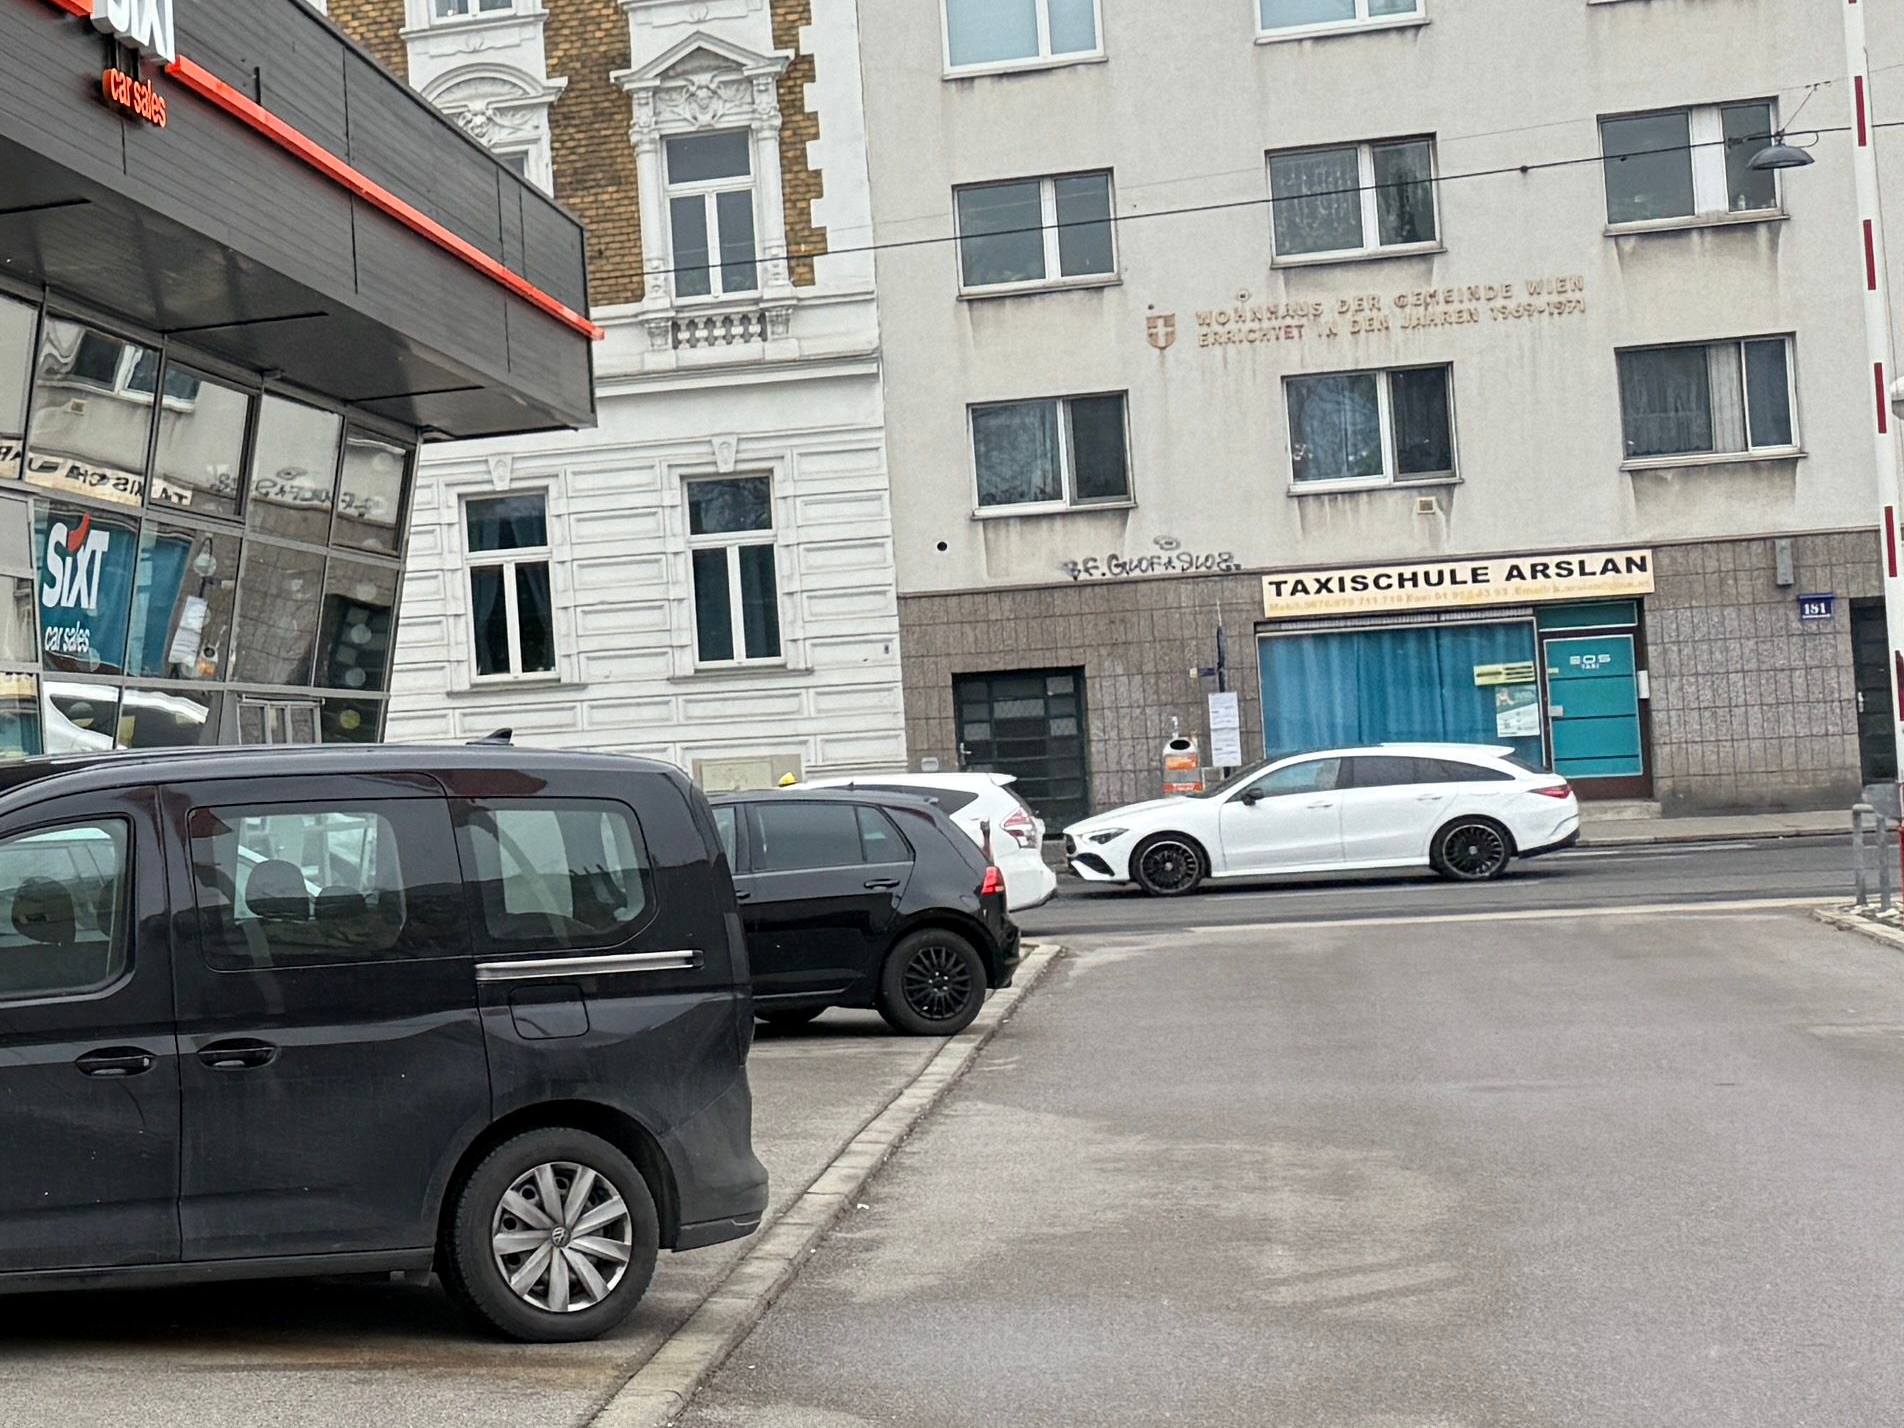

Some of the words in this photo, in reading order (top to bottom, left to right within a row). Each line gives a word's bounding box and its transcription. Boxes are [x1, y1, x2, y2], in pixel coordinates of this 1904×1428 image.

[106, 67, 132, 108] car
[133, 79, 167, 129] sales
[1196, 301, 1324, 327] WOHNHAUS
[1337, 292, 1382, 315] DER
[1394, 284, 1513, 309] GEMEINDE
[1526, 275, 1585, 297] WIEN
[1198, 324, 1305, 348] ERRICHTET
[1349, 314, 1390, 335] DEN
[1399, 307, 1480, 330] JAHREN
[42, 512, 110, 610] SIXT
[1268, 566, 1490, 597] TAXISCHULE
[1505, 555, 1648, 582] ARSLAN
[1803, 602, 1826, 615] 181
[44, 625, 62, 651] car
[63, 620, 91, 653] sales
